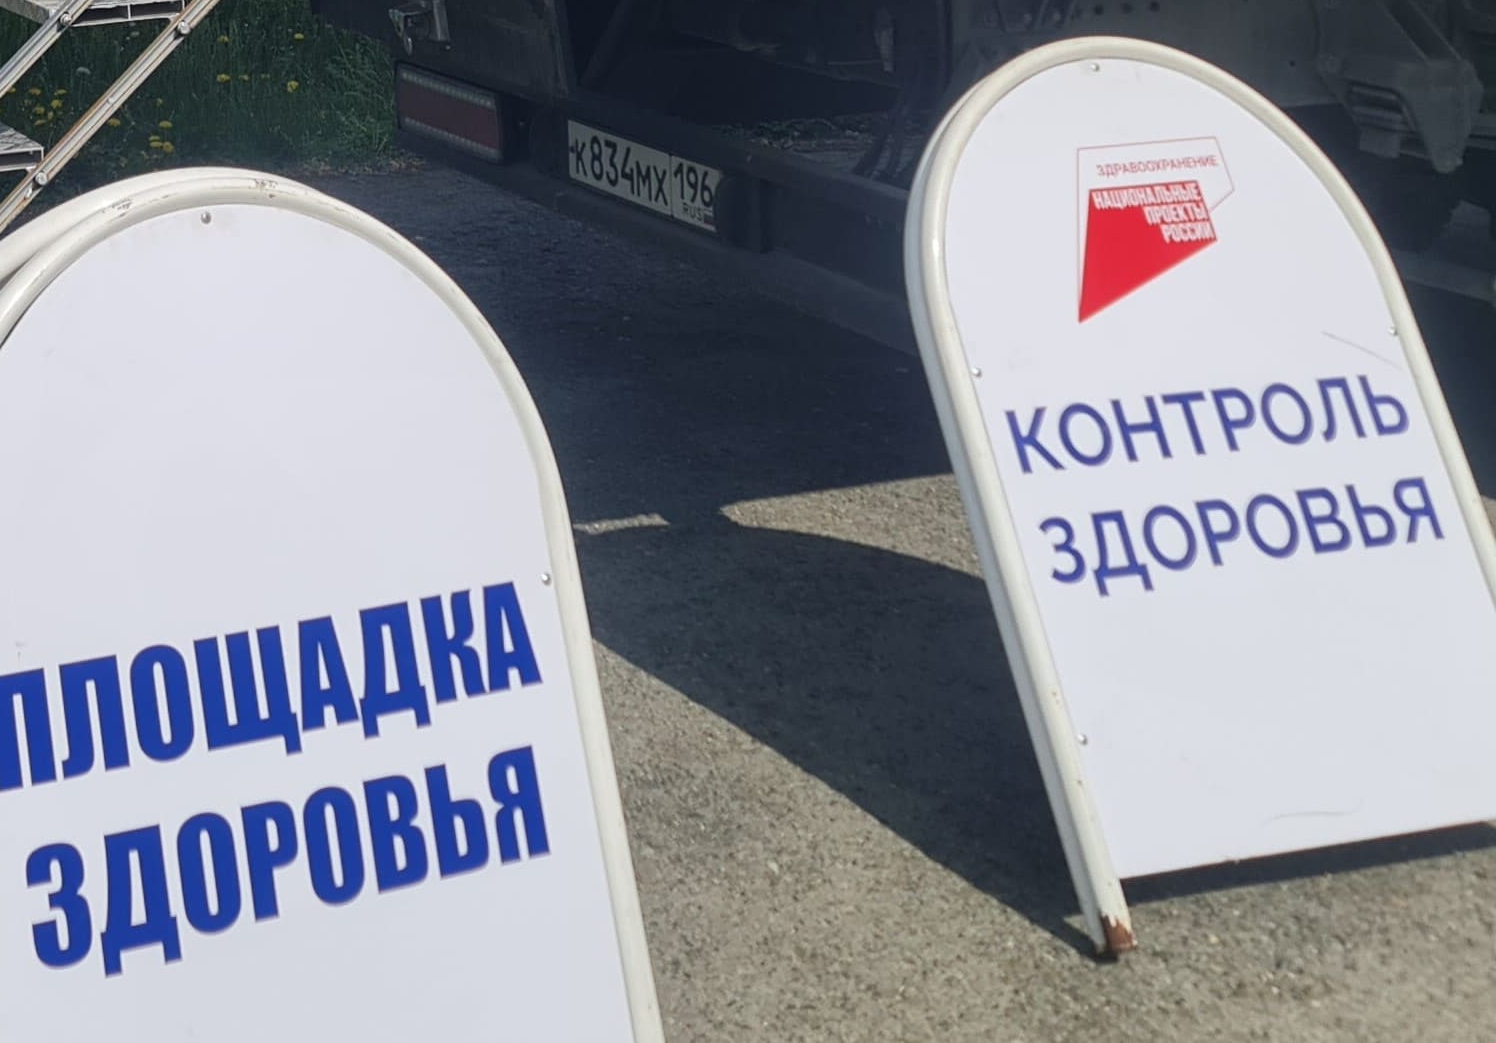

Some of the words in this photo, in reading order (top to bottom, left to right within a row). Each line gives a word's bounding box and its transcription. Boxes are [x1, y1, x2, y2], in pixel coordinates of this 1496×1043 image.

[673, 162, 714, 208] 196
[1095, 155, 1219, 178] ЗДРАВООХРАНЕНИЕ
[1091, 181, 1203, 210] НАЦИОНАЛЬНЫЕ
[1142, 201, 1210, 226] ПРОЕКТЫ
[1160, 221, 1215, 244] РОССИИ
[1005, 375, 1409, 474] КОНТРОЛЬ
[1038, 477, 1445, 597] ЗДОРОВЬЯ
[25, 745, 551, 979] ЗДОРОВЬЯ
